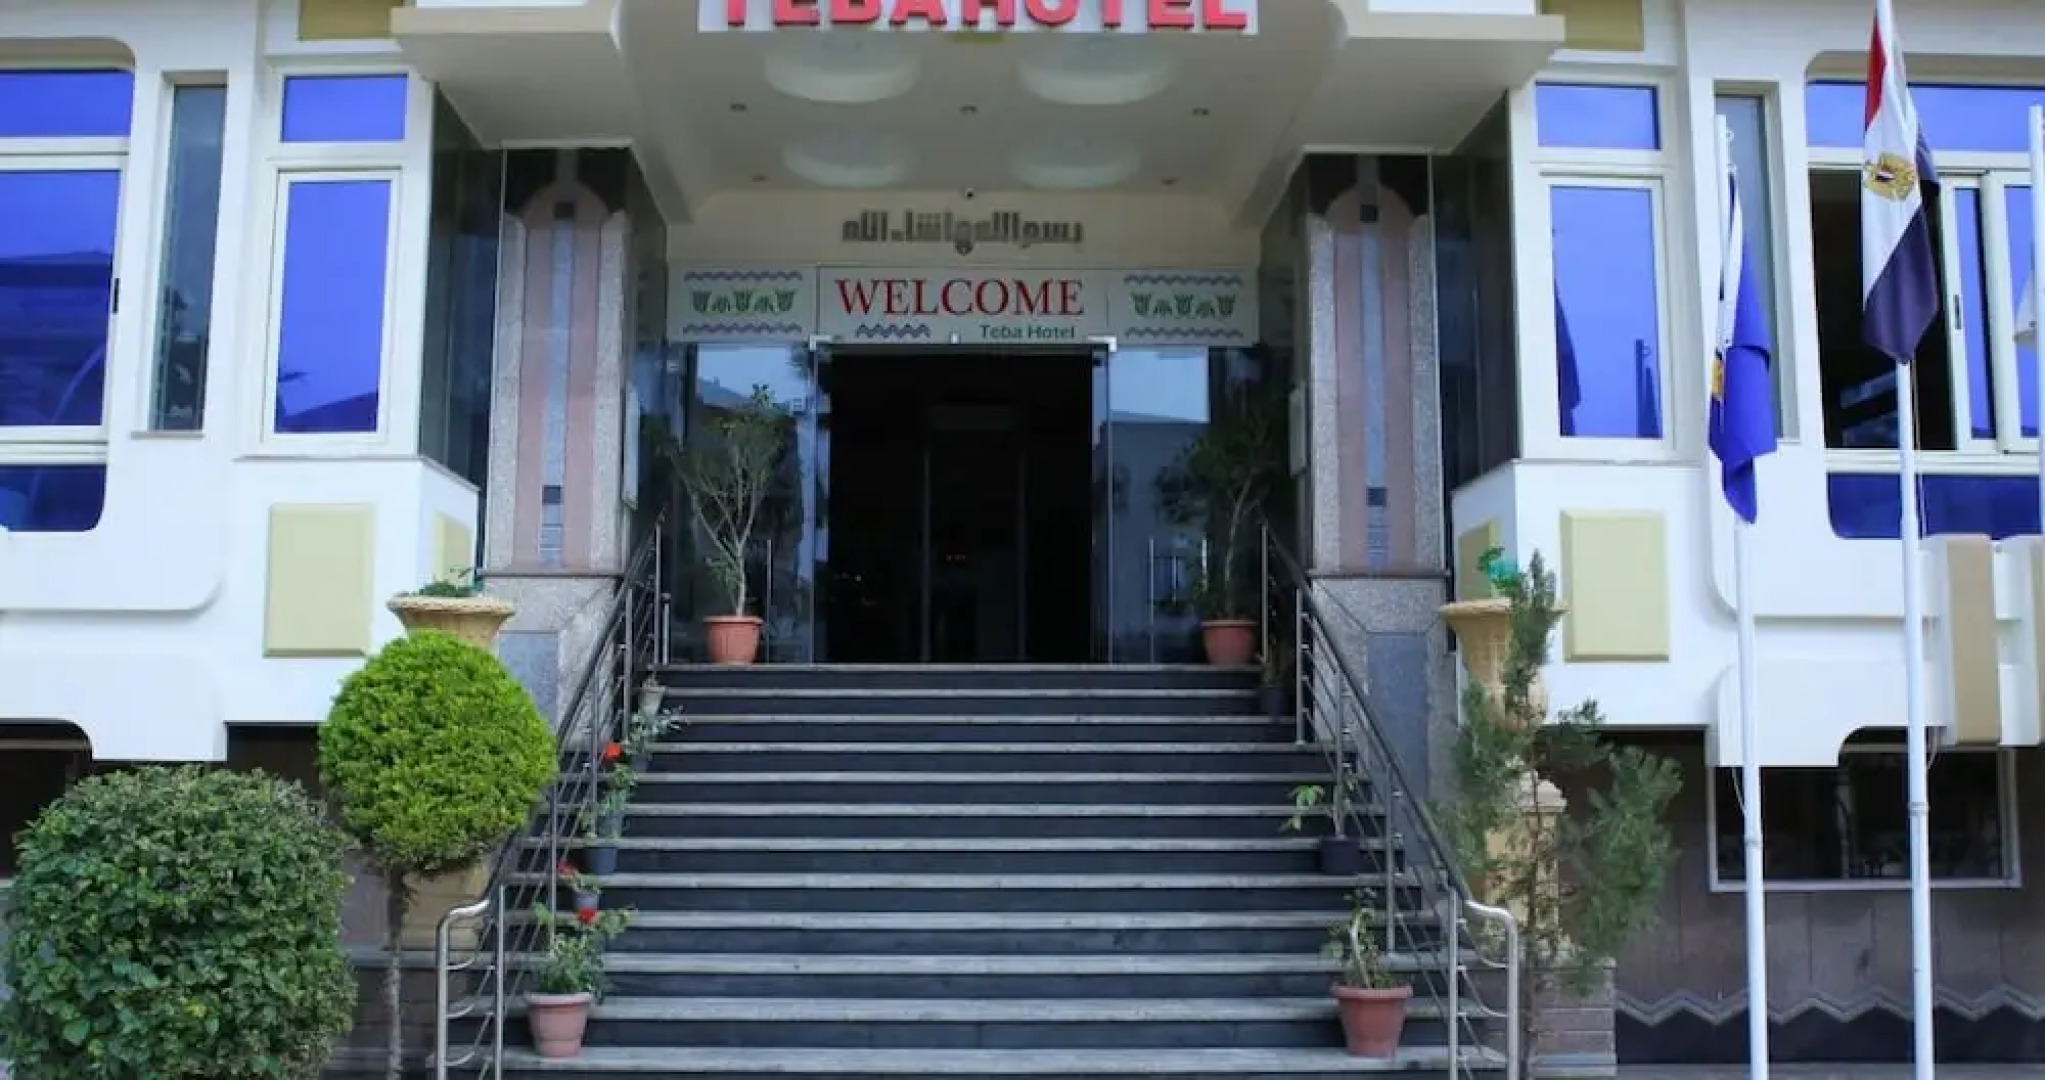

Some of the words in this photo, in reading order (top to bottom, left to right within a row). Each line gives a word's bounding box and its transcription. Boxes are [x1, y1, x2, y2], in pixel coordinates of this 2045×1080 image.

[834, 277, 1085, 316] WELCOME
[979, 324, 1023, 339] Teba
[1027, 323, 1075, 339] Hotel
